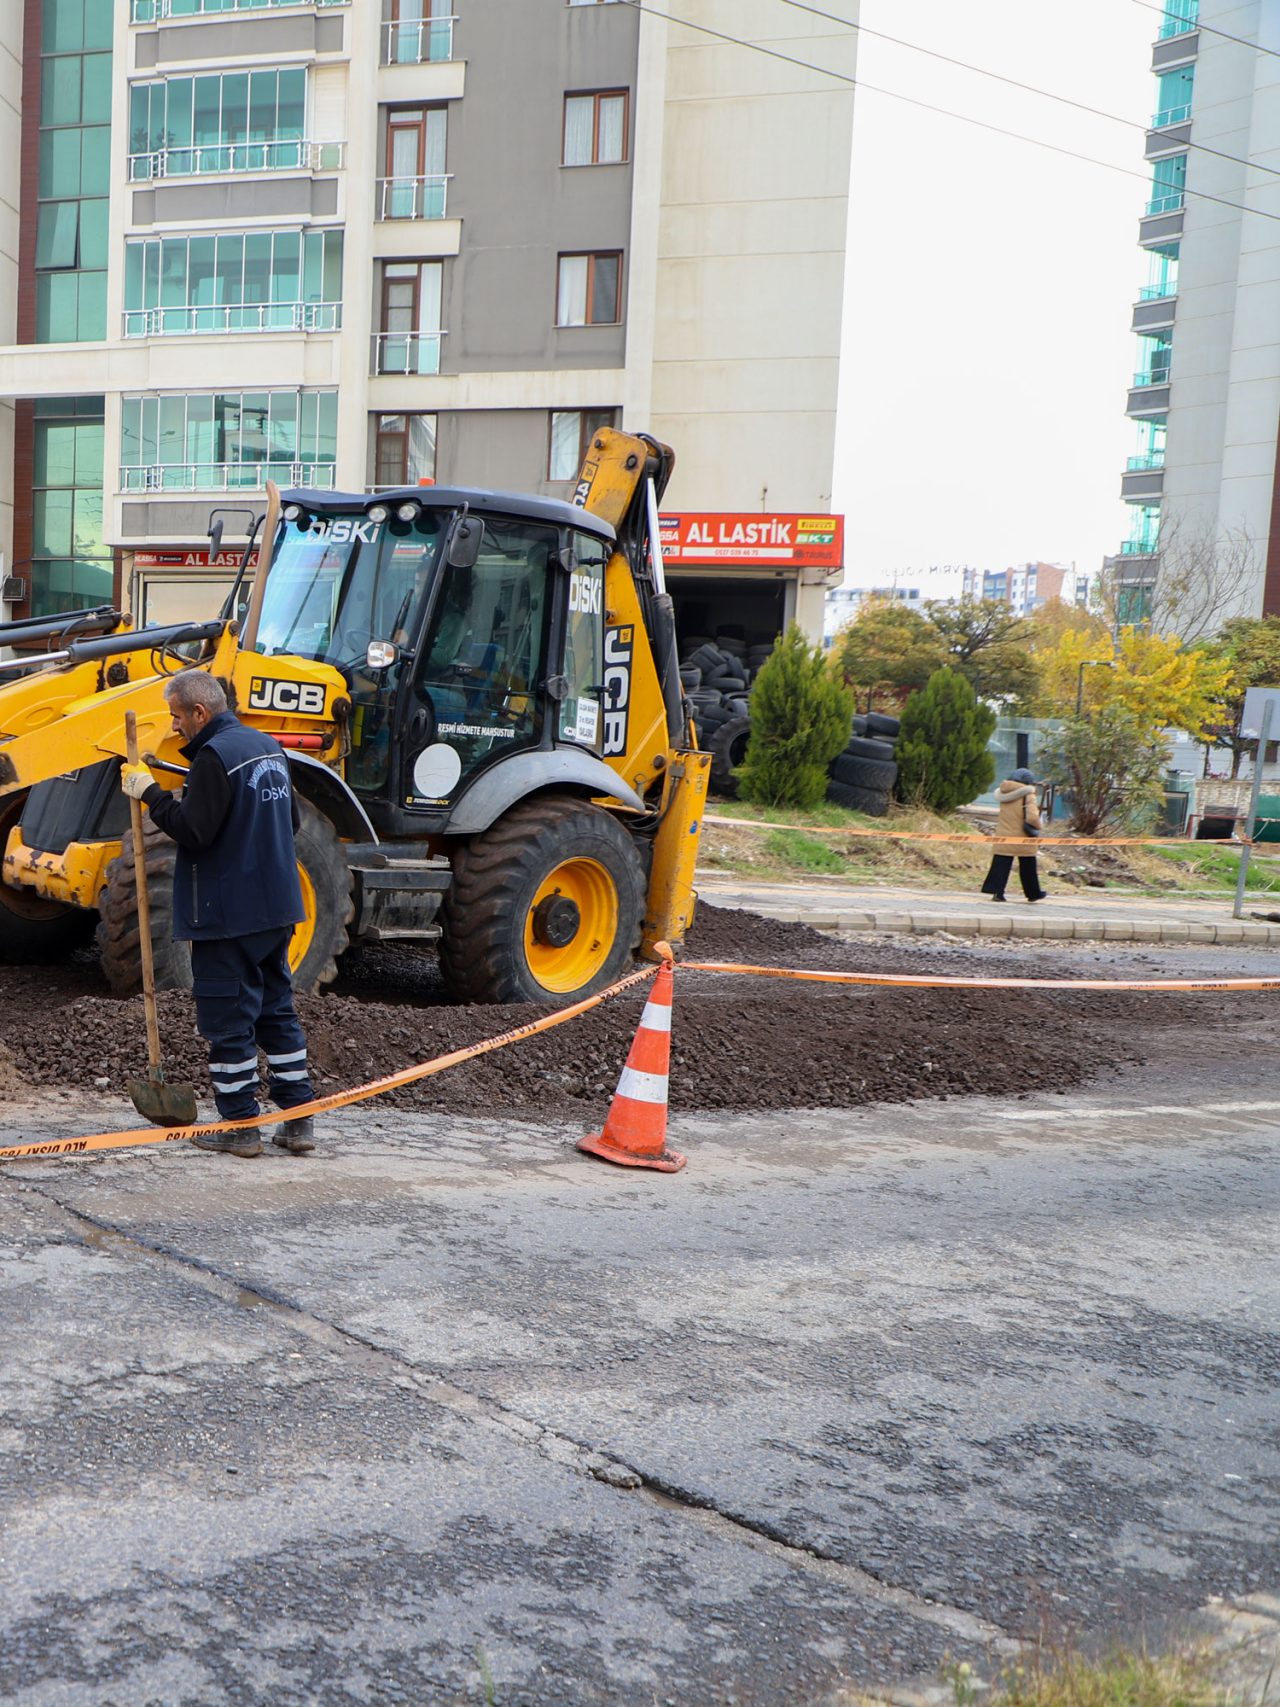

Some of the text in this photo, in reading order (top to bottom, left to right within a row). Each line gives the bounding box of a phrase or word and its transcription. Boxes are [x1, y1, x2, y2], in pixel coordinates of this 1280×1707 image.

[686, 518, 792, 544] AL LASTİK
[185, 553, 257, 566] AL LASTK
[250, 680, 324, 712] JCB
[604, 630, 630, 755] JCB
[437, 722, 456, 733] RESMİ
[456, 723, 481, 735] HİZMETE
